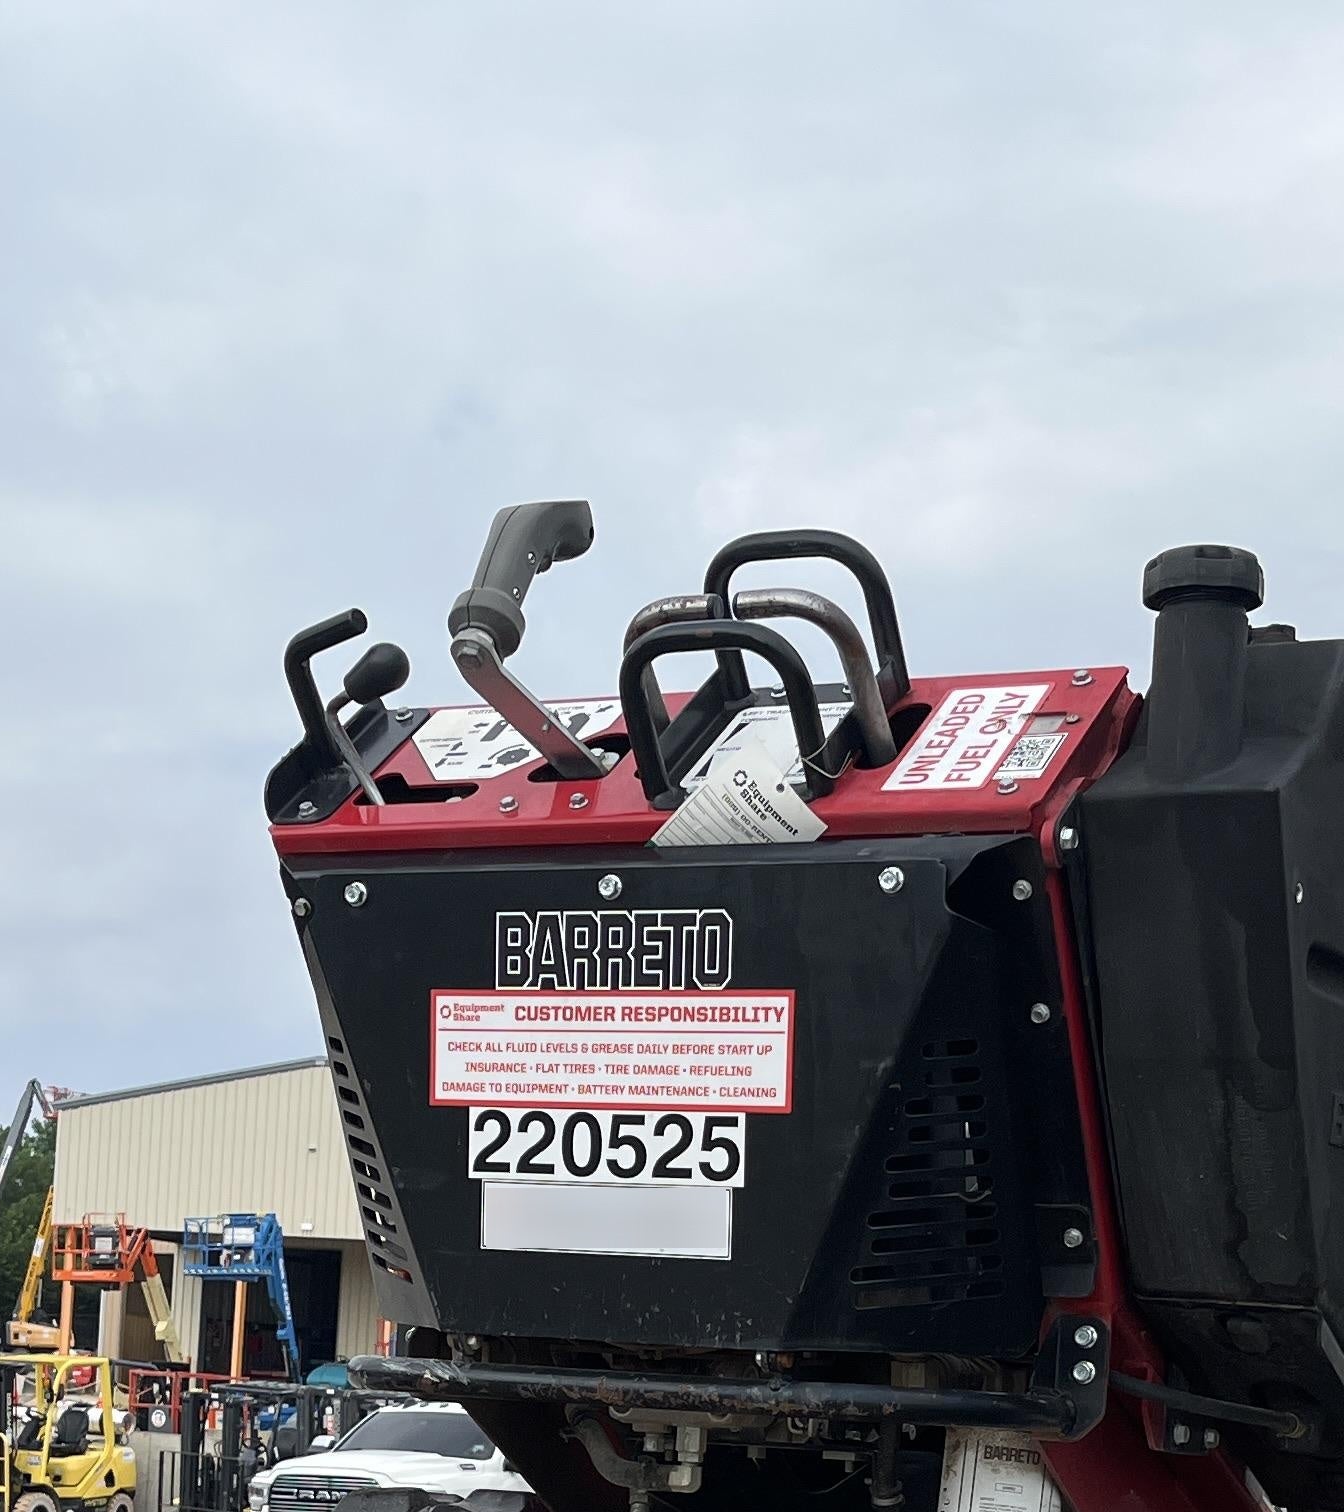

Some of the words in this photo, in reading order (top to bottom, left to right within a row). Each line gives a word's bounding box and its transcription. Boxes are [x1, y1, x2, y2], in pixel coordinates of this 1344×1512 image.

[899, 694, 986, 785] UNLEADED
[943, 738, 998, 783] FUEL
[979, 692, 1029, 735] ONLY
[740, 788, 767, 821] Share
[748, 780, 798, 836] Equipment
[495, 909, 733, 991] BARRETO
[453, 1003, 505, 1013] Equipment
[453, 1013, 481, 1021] Share
[514, 1006, 616, 1022] CUSTOMER
[621, 1006, 785, 1023] RESPONSIBILITY
[447, 1041, 483, 1052] CHECK
[485, 1042, 504, 1053] ALL
[506, 1042, 537, 1053] FLUID
[540, 1043, 578, 1054] LEVELS
[591, 1043, 634, 1054] GREASE
[637, 1044, 669, 1055] DAILY
[672, 1044, 715, 1055] BEFORE
[718, 1044, 754, 1056] START
[756, 1045, 773, 1056] UP
[465, 1062, 527, 1073] INSURANCE
[535, 1063, 560, 1074] FLAT
[563, 1063, 595, 1074] TIRES
[604, 1064, 630, 1075] TIRE
[633, 1064, 680, 1076] DAMAGE
[689, 1065, 752, 1077] REFUELING
[442, 1081, 486, 1092] DAMAGE
[489, 1082, 502, 1093] TO
[505, 1082, 569, 1094] EQUIPMENT
[577, 1084, 626, 1096] BATTERY
[628, 1085, 710, 1097] MAINTENANCE
[719, 1086, 777, 1098] CLEANING
[472, 1109, 740, 1182] 220525
[984, 1445, 1041, 1465] BARRETO
